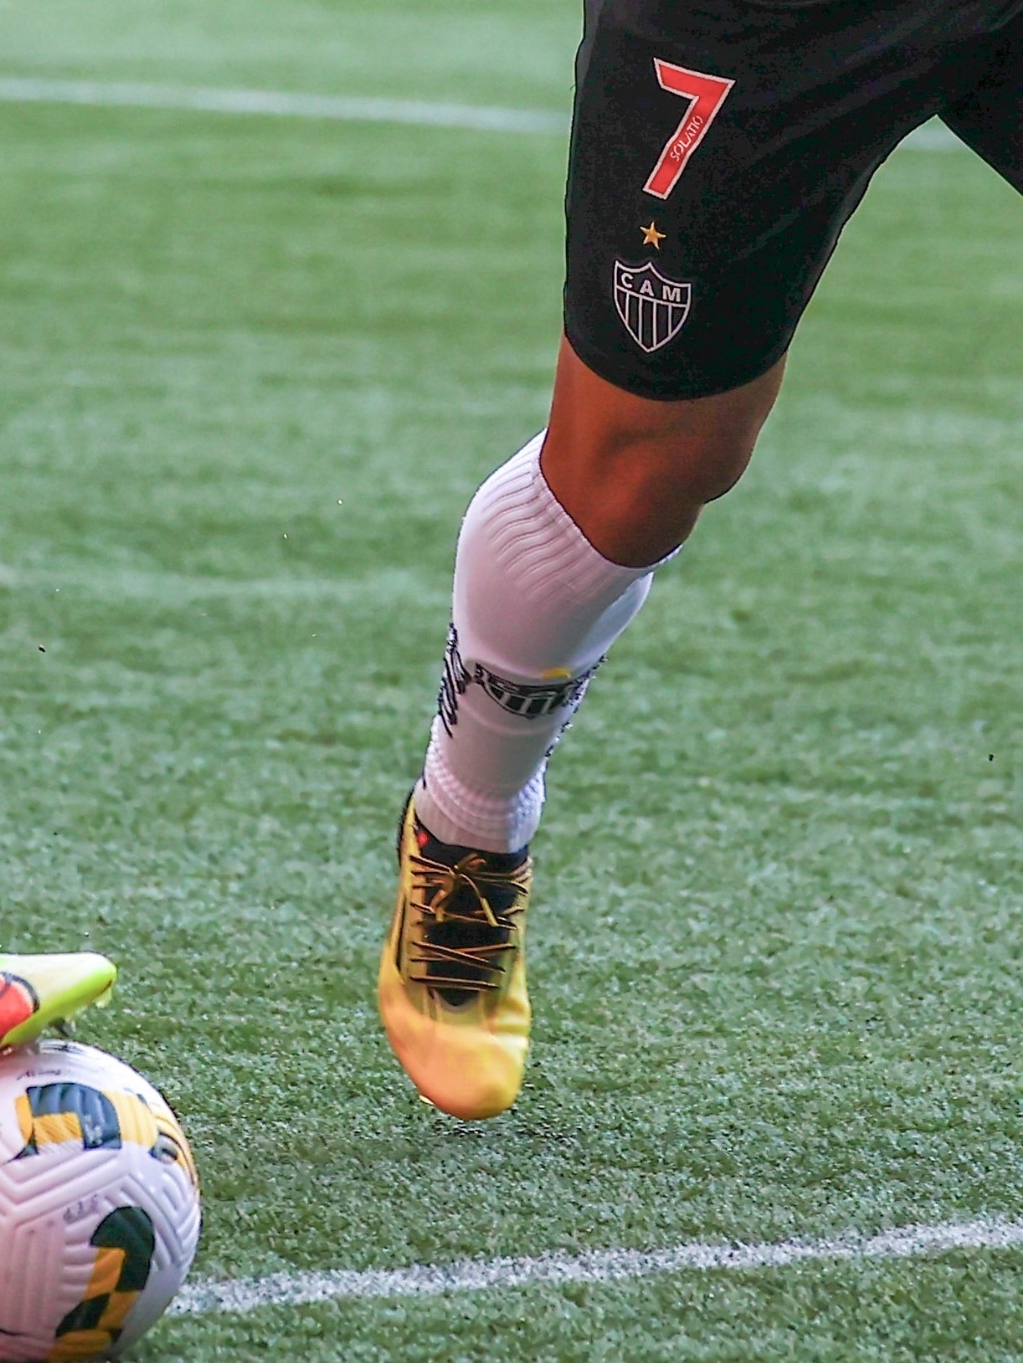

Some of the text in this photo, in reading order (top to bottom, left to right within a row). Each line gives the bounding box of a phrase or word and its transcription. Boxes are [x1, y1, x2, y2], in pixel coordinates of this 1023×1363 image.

[642, 57, 736, 200] 7
[670, 115, 703, 162] SOLATIO
[620, 273, 681, 303] CAM
